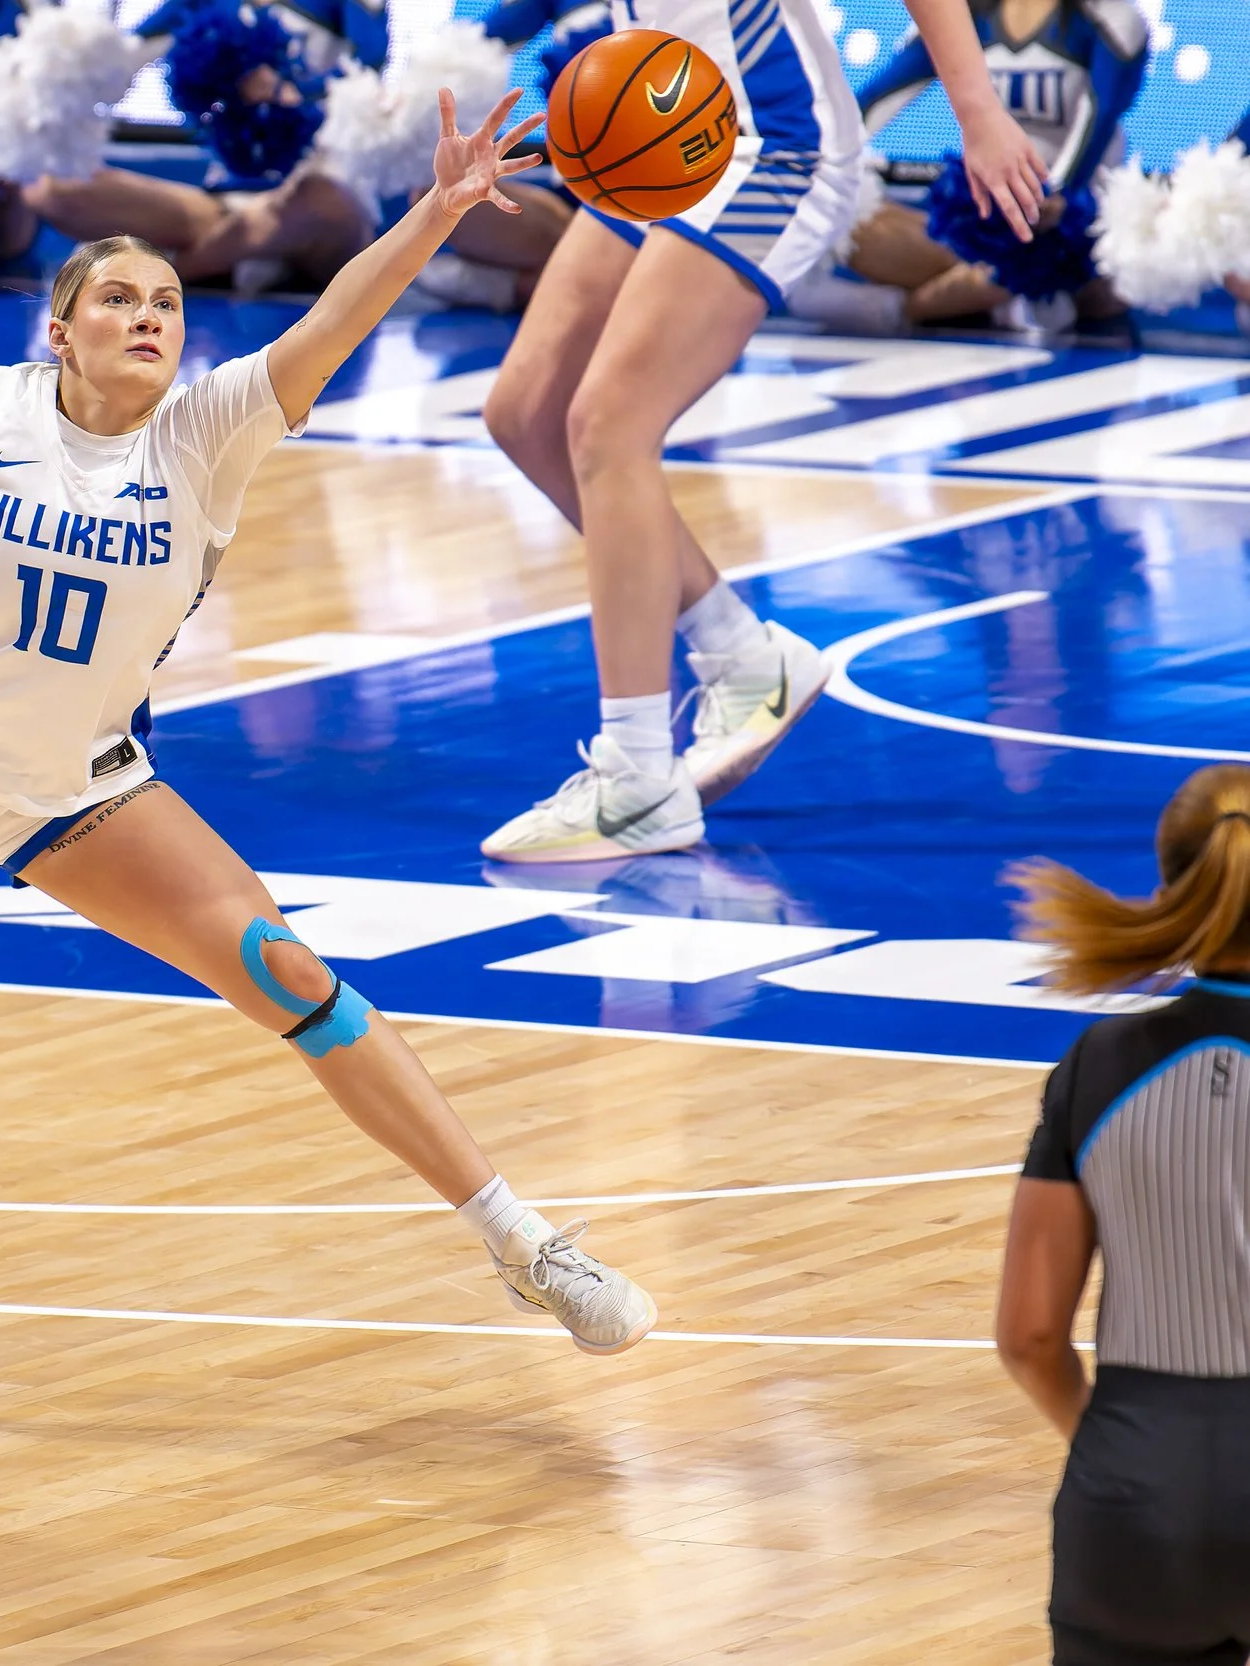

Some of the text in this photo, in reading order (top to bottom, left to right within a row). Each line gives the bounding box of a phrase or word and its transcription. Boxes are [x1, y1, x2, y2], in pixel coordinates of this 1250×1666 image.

[988, 67, 1064, 123] LU
[12, 563, 108, 665] 10
[49, 782, 161, 853] DIVINE FEMININE
